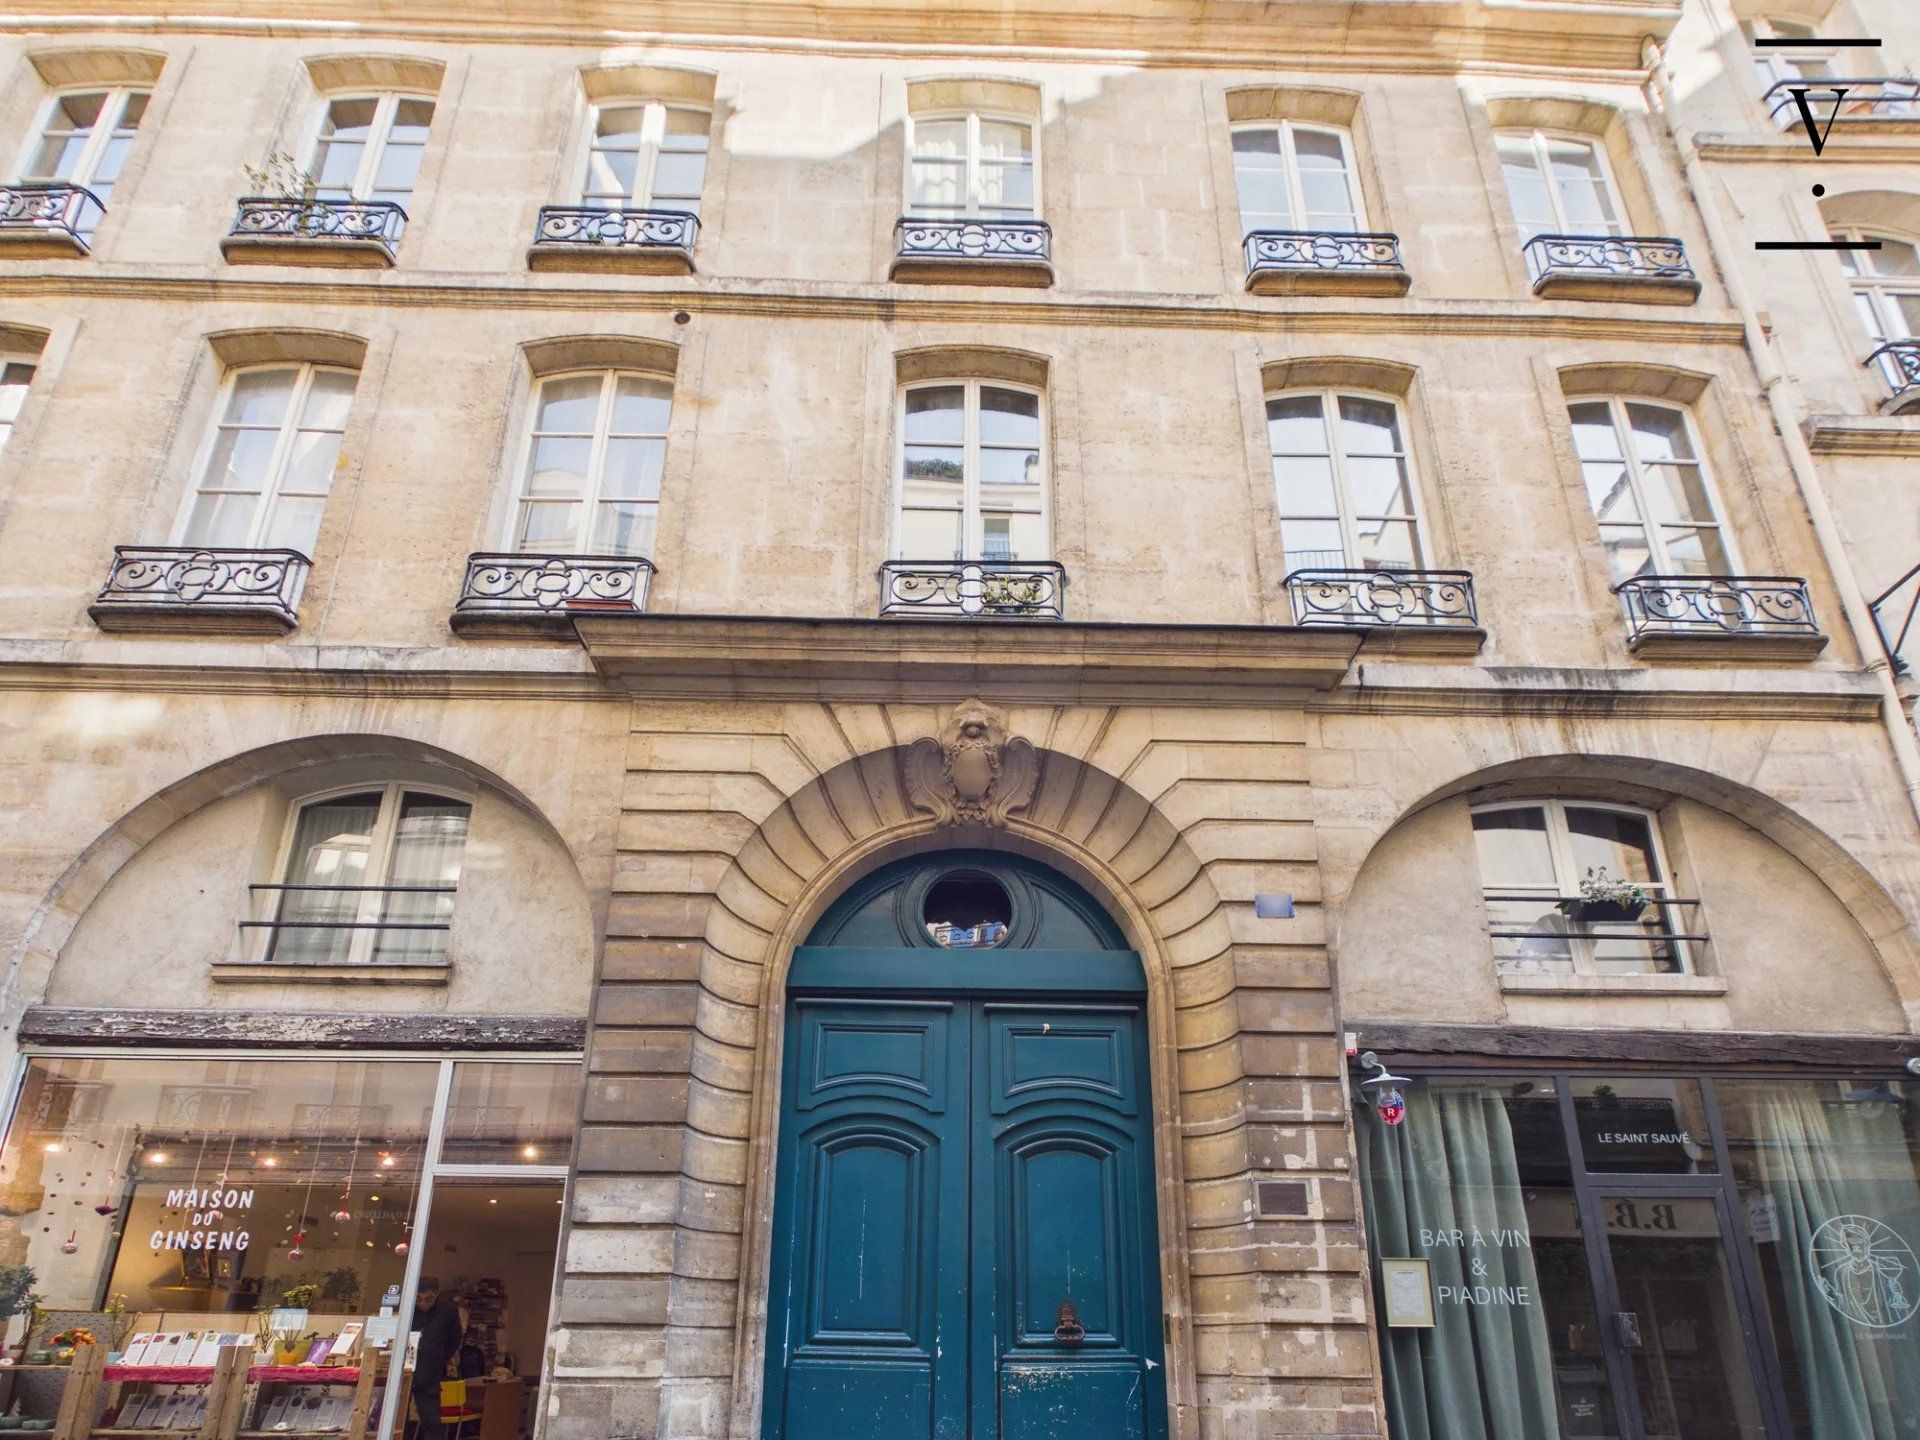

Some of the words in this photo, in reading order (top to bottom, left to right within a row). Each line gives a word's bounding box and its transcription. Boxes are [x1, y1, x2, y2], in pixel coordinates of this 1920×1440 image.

[1387, 1107, 1396, 1117] R
[1597, 1133, 1613, 1143] LE
[1614, 1133, 1648, 1144] SAINT
[1650, 1131, 1691, 1144] SAUVÉ
[166, 1188, 255, 1209] MAISON
[192, 1212, 214, 1226] DU
[150, 1230, 250, 1251] GINSENG
[1420, 1228, 1465, 1248] BAR
[1471, 1224, 1487, 1248] À
[1490, 1229, 1531, 1248] VIN
[1471, 1257, 1488, 1276] &
[1437, 1285, 1531, 1306] PIADINE
